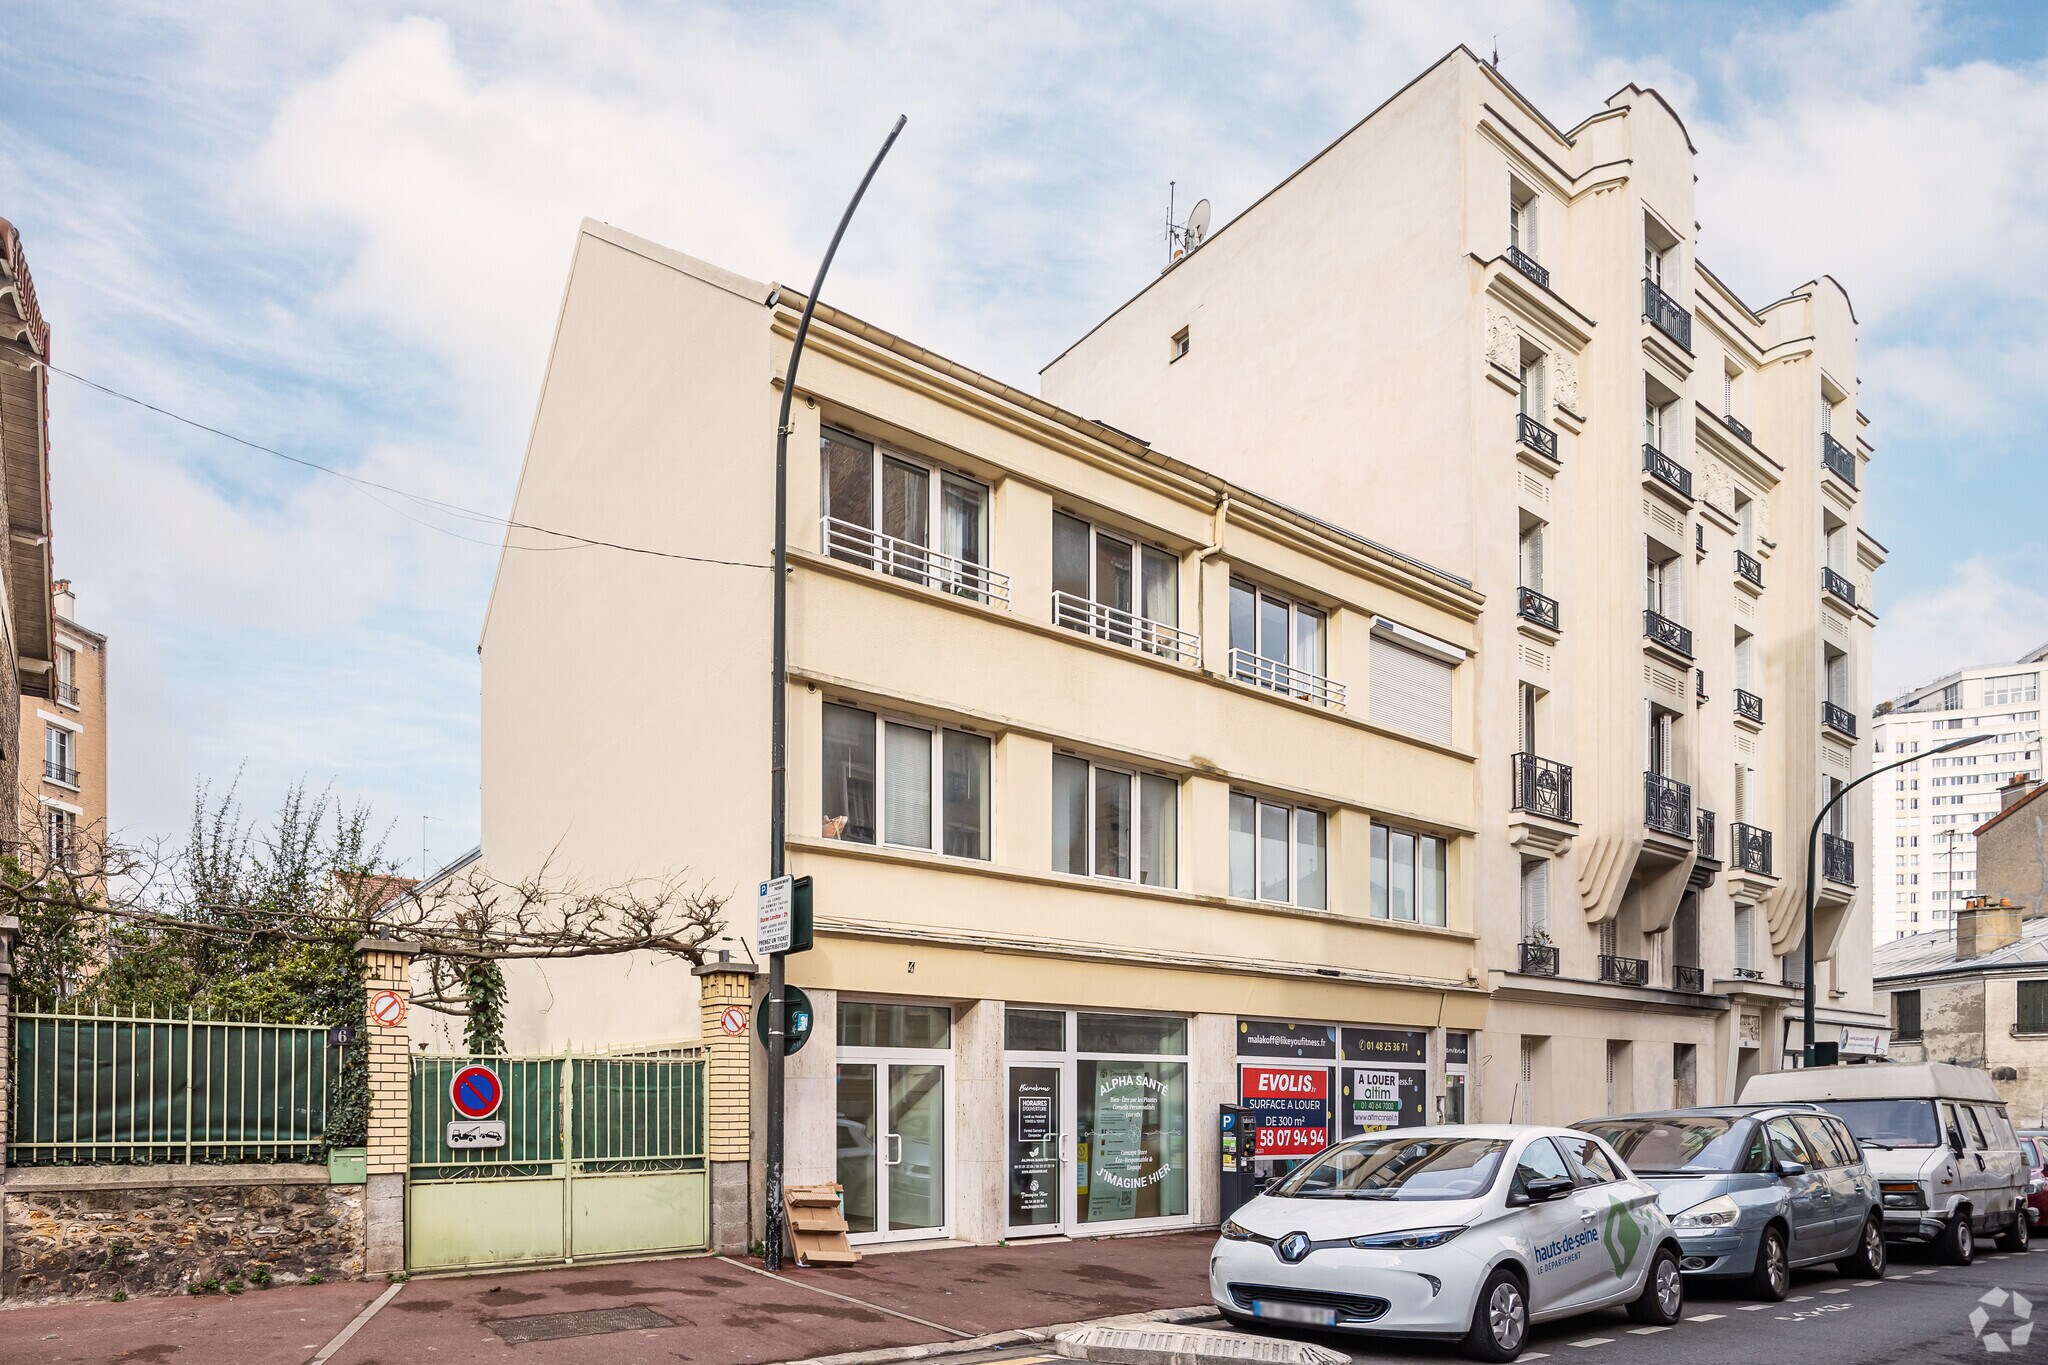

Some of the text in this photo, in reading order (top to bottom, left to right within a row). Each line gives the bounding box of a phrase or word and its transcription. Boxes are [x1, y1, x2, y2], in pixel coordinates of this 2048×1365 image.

[765, 942, 788, 951] DISTRIBUTEUR
[908, 962, 915, 973] 4
[338, 1030, 347, 1042] 6
[1248, 1035, 1326, 1047] malakoff@likeyoufitness.fr
[1367, 1042, 1408, 1052] 01 48 25 36 71
[1100, 1075, 1168, 1096] ALPHA SANTÉ
[1359, 1074, 1395, 1086] A LOUER
[1400, 1077, 1413, 1086] ess.fr
[1365, 1086, 1390, 1099] altim
[1250, 1099, 1320, 1109] SURFACE A LOUER
[1223, 1116, 1231, 1127] P
[1266, 1116, 1277, 1126] DE
[1278, 1117, 1292, 1126] 300
[1260, 1129, 1324, 1146] 58 07 94 94
[1096, 1167, 1147, 1188] J'IMAGINE
[1149, 1163, 1171, 1184] HIER
[1537, 1251, 1581, 1275] LE DÉPARTEMENT
